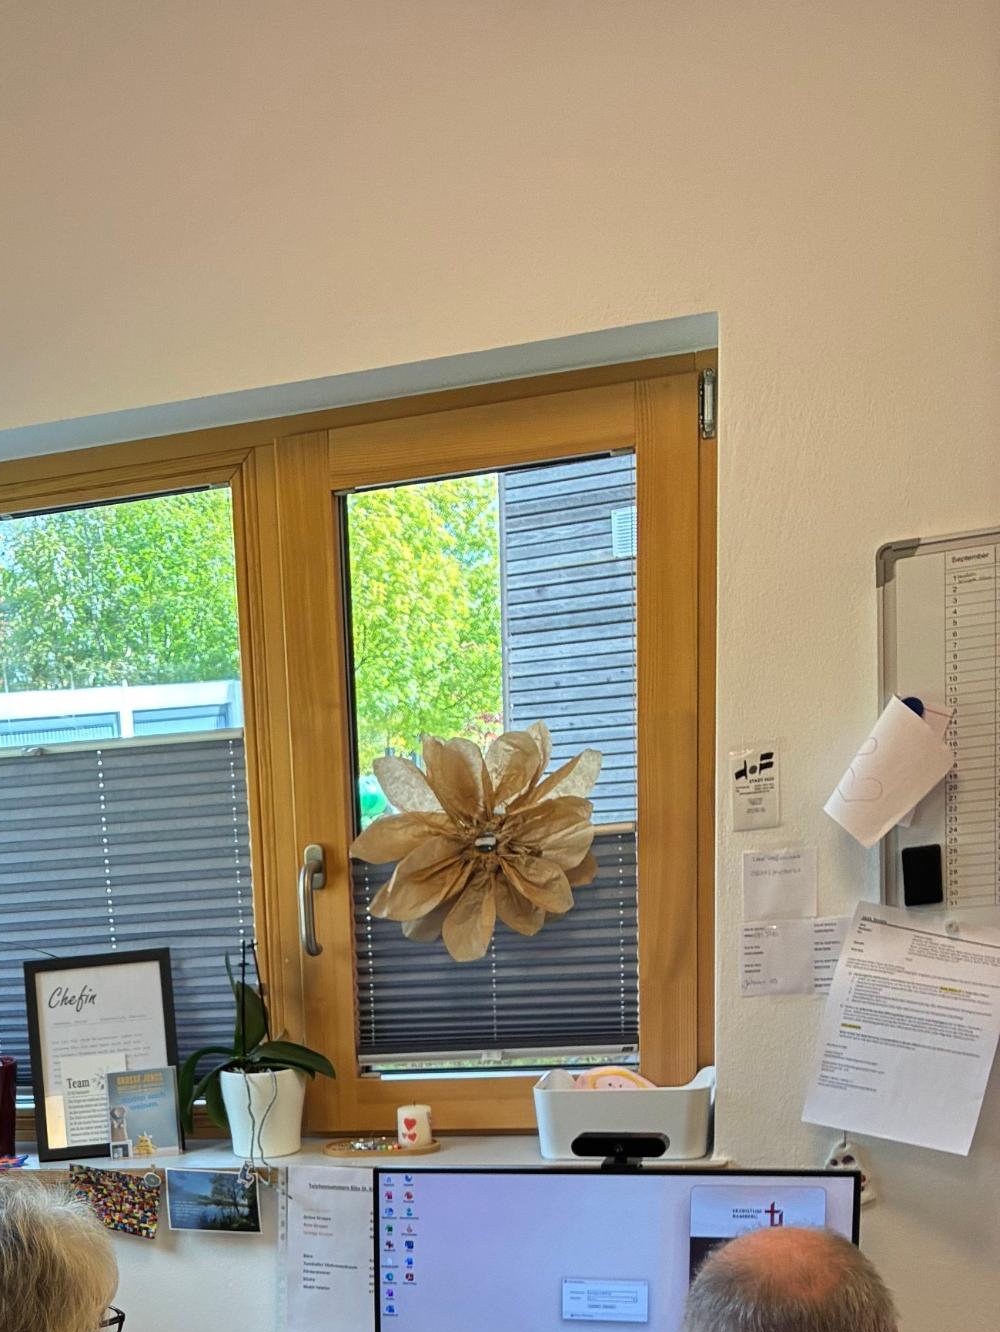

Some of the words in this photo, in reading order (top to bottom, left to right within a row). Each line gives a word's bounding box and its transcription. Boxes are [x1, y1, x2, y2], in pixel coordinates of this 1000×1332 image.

[951, 552, 990, 564] September
[47, 984, 97, 1013] Chefin
[66, 1078, 90, 1089] Team
